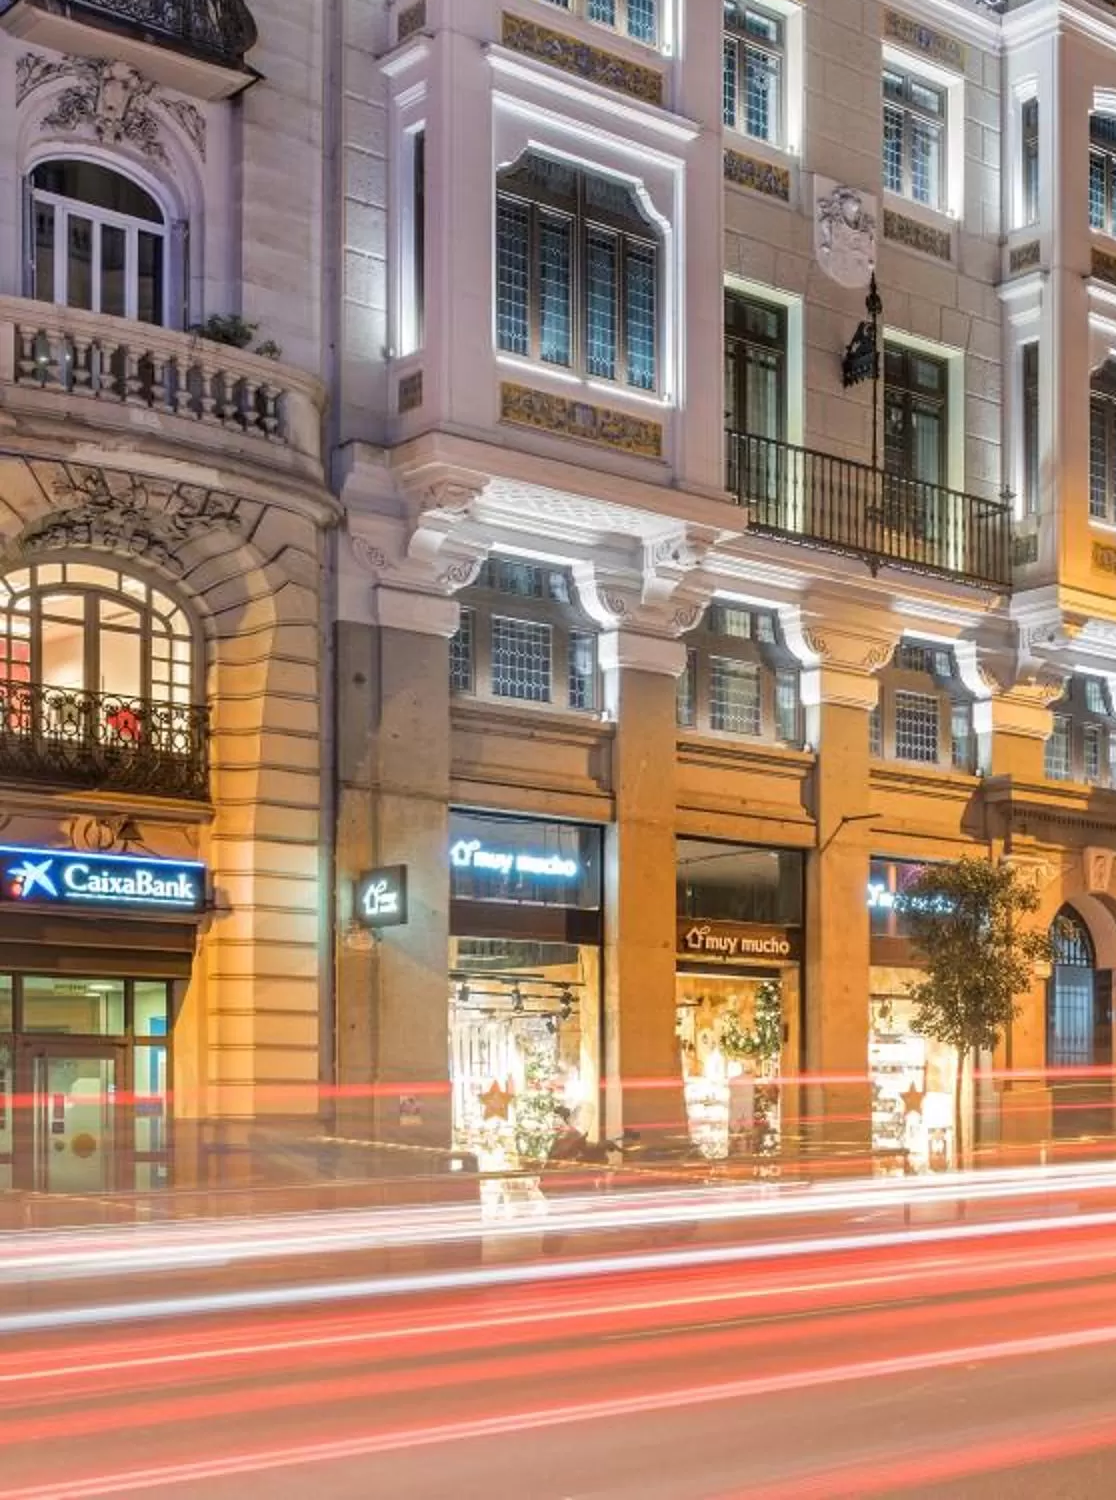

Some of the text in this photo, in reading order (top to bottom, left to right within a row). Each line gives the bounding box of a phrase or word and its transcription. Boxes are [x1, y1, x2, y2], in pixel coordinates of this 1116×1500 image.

[64, 863, 195, 899] CaixaBank
[705, 935, 790, 956] muy mucho
